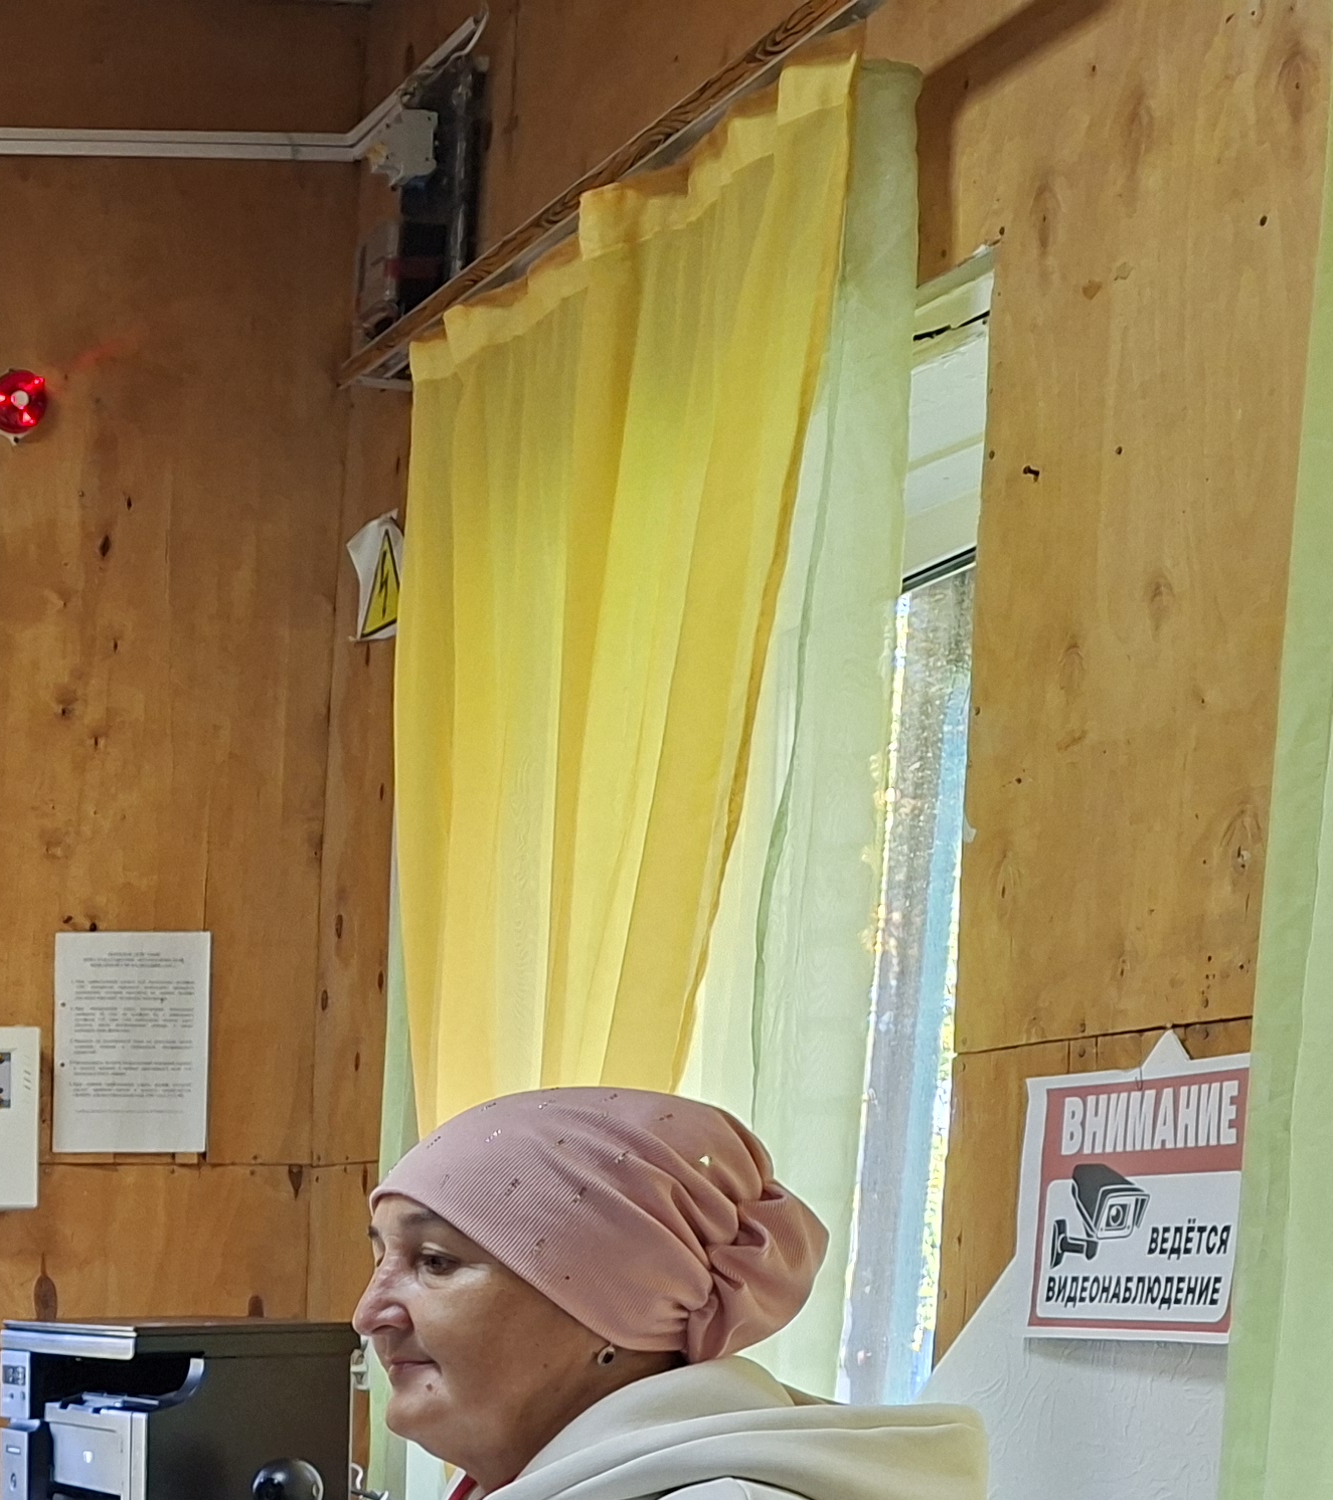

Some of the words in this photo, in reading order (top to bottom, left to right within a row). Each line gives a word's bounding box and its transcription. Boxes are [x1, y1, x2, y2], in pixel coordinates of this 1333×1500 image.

[1061, 1080, 1239, 1156] ВНИМАНИЕ
[1147, 1219, 1232, 1260] ВЕДЁТСЯ
[1045, 1275, 1223, 1310] ВИДЕОНАБЛЮДЕНИЕ
